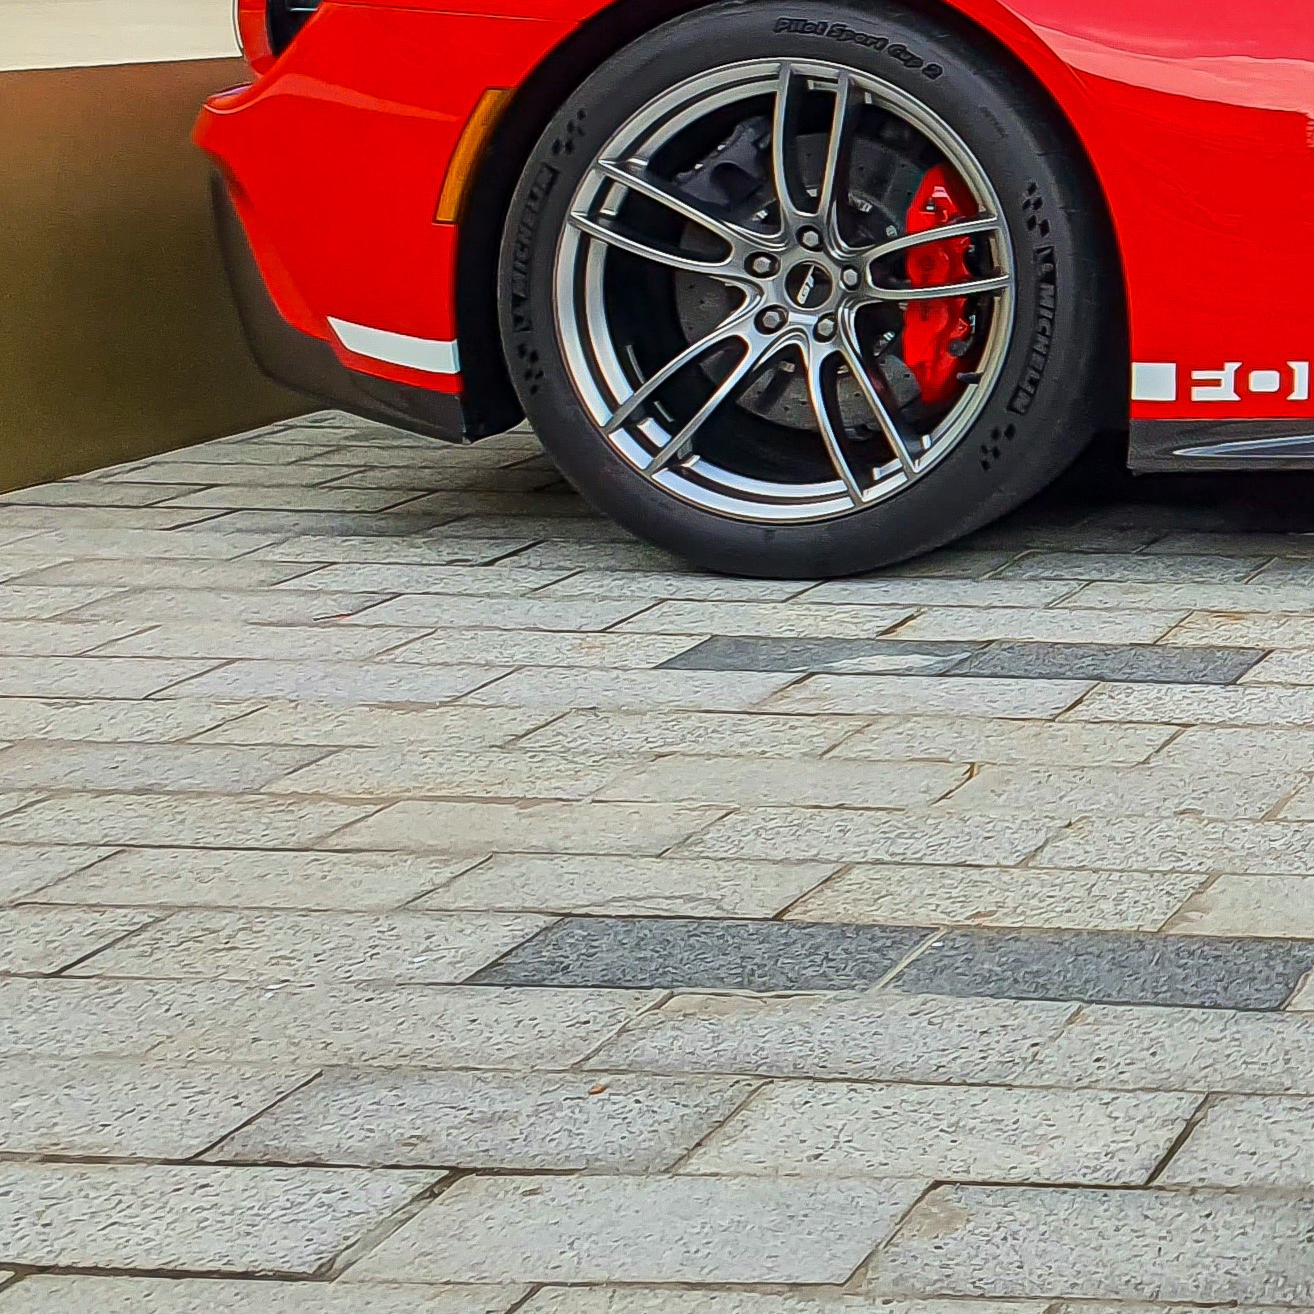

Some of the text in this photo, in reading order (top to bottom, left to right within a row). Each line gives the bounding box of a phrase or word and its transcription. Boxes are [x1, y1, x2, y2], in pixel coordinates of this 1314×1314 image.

[773, 17, 829, 35] Pilot
[827, 22, 889, 52] Sport
[921, 62, 943, 81] 2
[1010, 284, 1055, 415] MICHELIN
